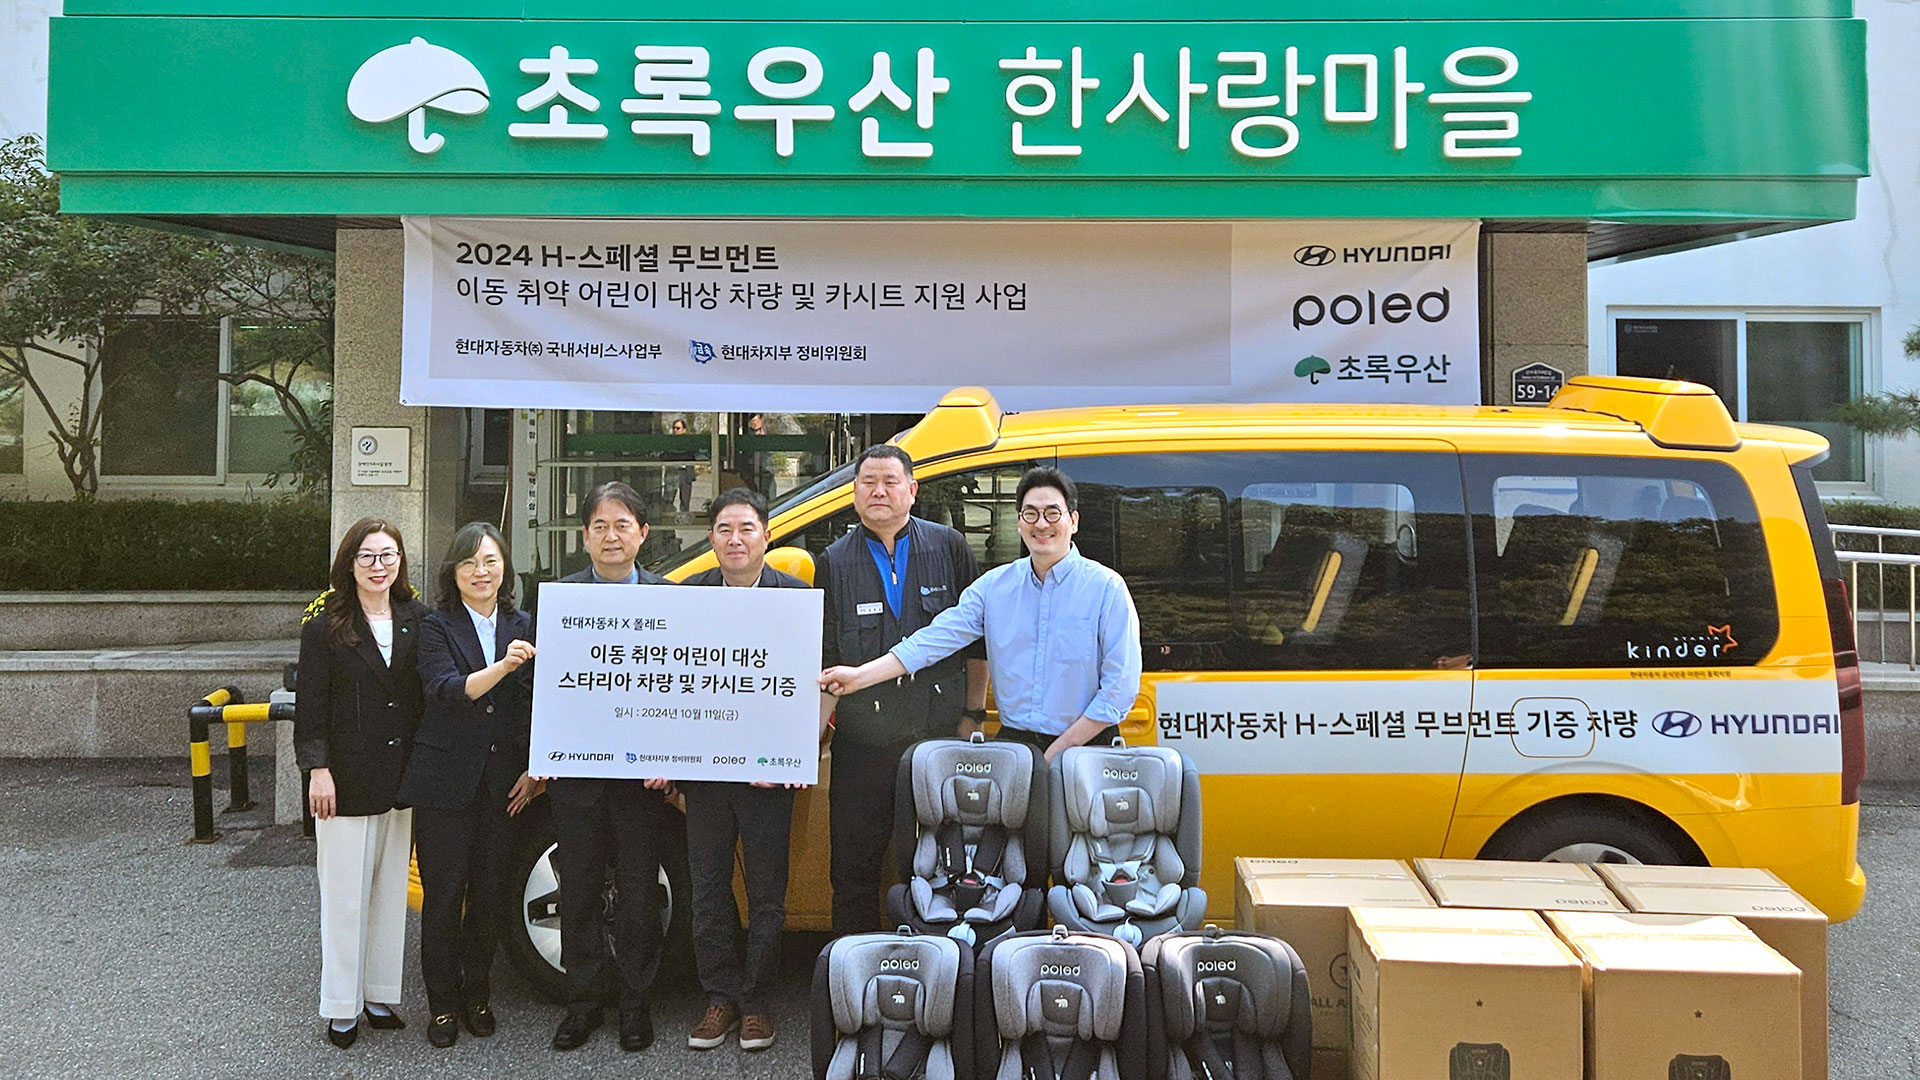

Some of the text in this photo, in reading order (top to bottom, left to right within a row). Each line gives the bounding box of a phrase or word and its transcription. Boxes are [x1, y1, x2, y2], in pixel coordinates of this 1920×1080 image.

[508, 46, 1532, 157] 초록우산 한사랑마을
[456, 241, 778, 272] 2024 H-스페셜 무브먼트
[1343, 243, 1451, 264] HYUNDAI
[457, 277, 1025, 310] 이동 취약 어린이 대상 차량 및 카시트 지원 사업
[1293, 287, 1449, 330] poled
[545, 341, 663, 360] 국내서비스사업부
[720, 344, 867, 362] 현대차지부 정비위원회
[1337, 355, 1451, 383] 초록우산
[561, 616, 619, 631] 현대자동차
[621, 618, 630, 629] X
[590, 644, 769, 669] 이동 취약 어린이 대상
[1627, 641, 1720, 659] kinder
[557, 670, 797, 698] 스타리아 차량 및 카시트 기증
[614, 706, 634, 718] 일시
[641, 707, 678, 720] 2024년
[680, 708, 702, 721] 10월
[704, 709, 739, 721] 11일(금)
[1158, 710, 1638, 739] 현대자동차 H-스페셜 무브먼트 기증 차량
[1710, 714, 1840, 735] HYUNDAI
[568, 752, 614, 761] HYUNDAI
[712, 755, 747, 765] poled
[955, 761, 992, 774] poled
[1102, 767, 1139, 781] poled
[880, 956, 920, 972] poled
[1040, 964, 1081, 977] poled
[1197, 959, 1237, 973] poled
